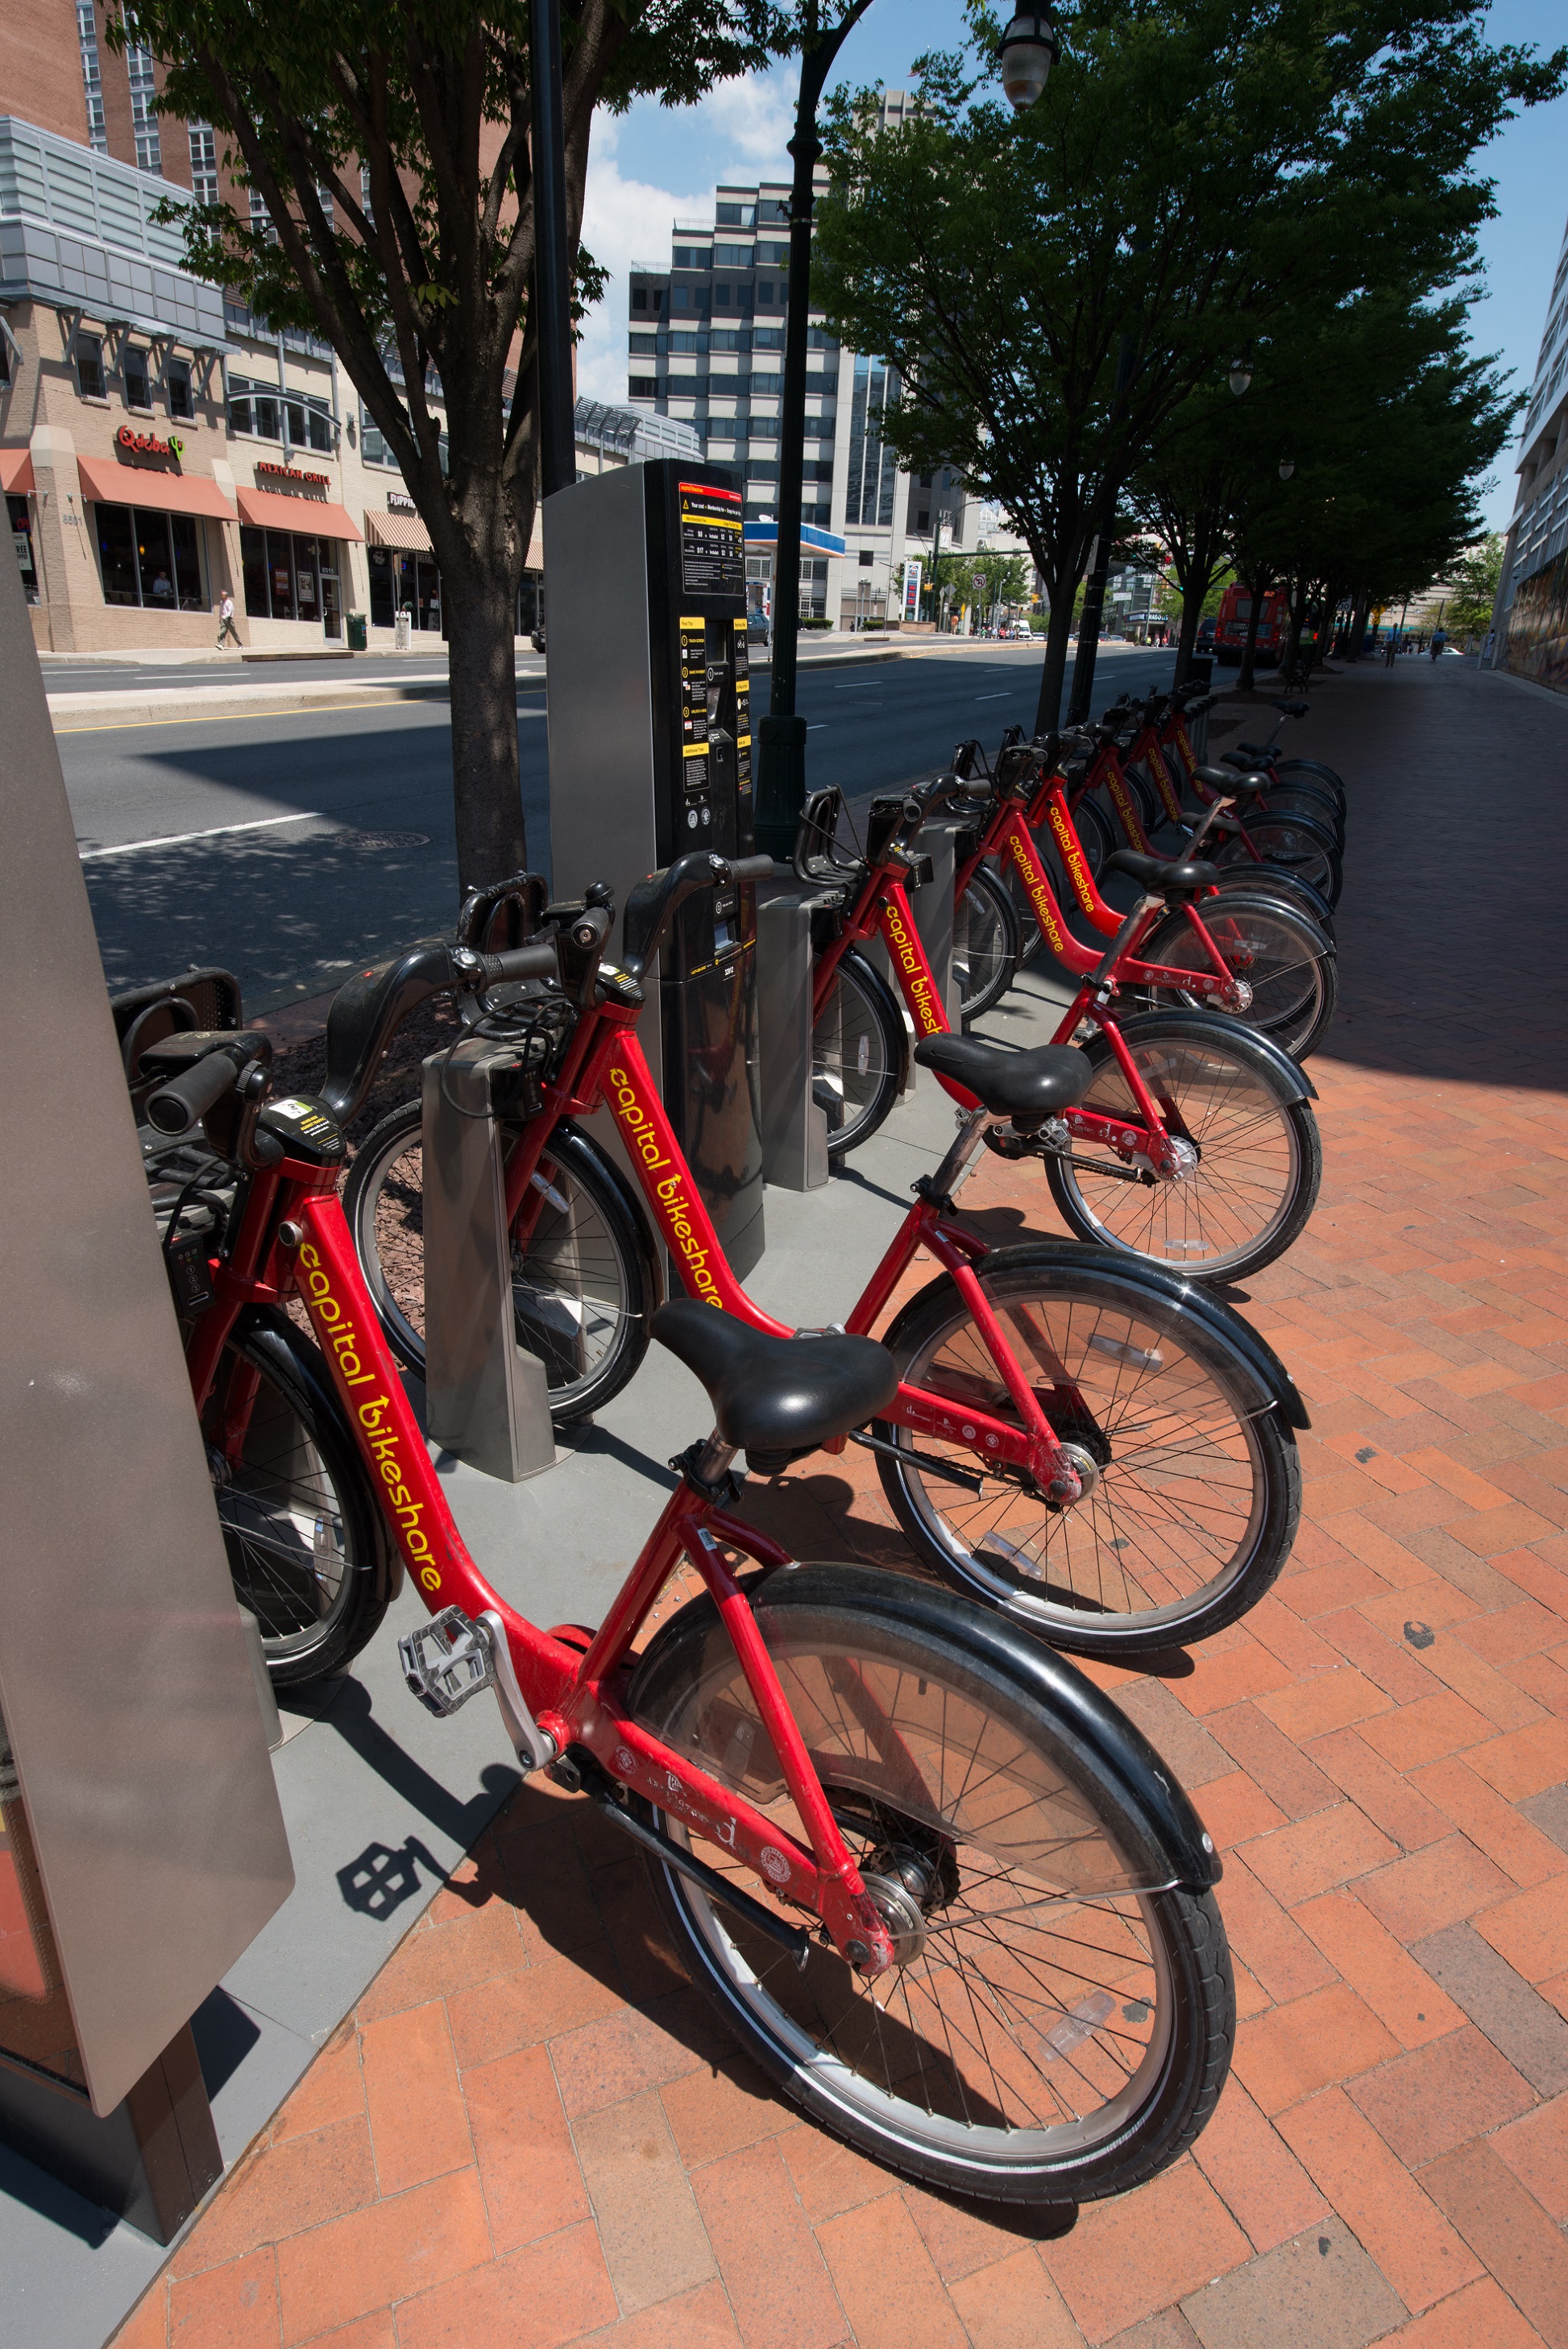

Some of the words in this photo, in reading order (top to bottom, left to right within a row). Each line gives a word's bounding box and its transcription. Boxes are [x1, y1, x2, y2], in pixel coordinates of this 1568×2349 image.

[118, 425, 170, 455] Qdoba
[259, 461, 303, 479] MEXICAN
[305, 471, 331, 485] GRILL
[16, 546, 27, 554] REE
[17, 518, 31, 529] OPE
[1177, 729, 1190, 756] capital
[1107, 771, 1128, 807] capital
[1122, 807, 1145, 854] bikeshare
[1148, 748, 1165, 778] capital
[1159, 778, 1179, 821] bikeshare
[1010, 836, 1039, 885] capital
[1031, 884, 1064, 952] bikeshare
[1050, 807, 1076, 852] capital
[1068, 851, 1094, 912] bikeshare
[886, 906, 922, 973] capital
[911, 976, 943, 1034] bikesh
[301, 1123, 313, 1131] AGAINST
[610, 1068, 670, 1170] capital
[657, 1173, 723, 1309] bikeshare
[300, 1243, 375, 1386] capital
[359, 1395, 442, 1592] bikeshare
